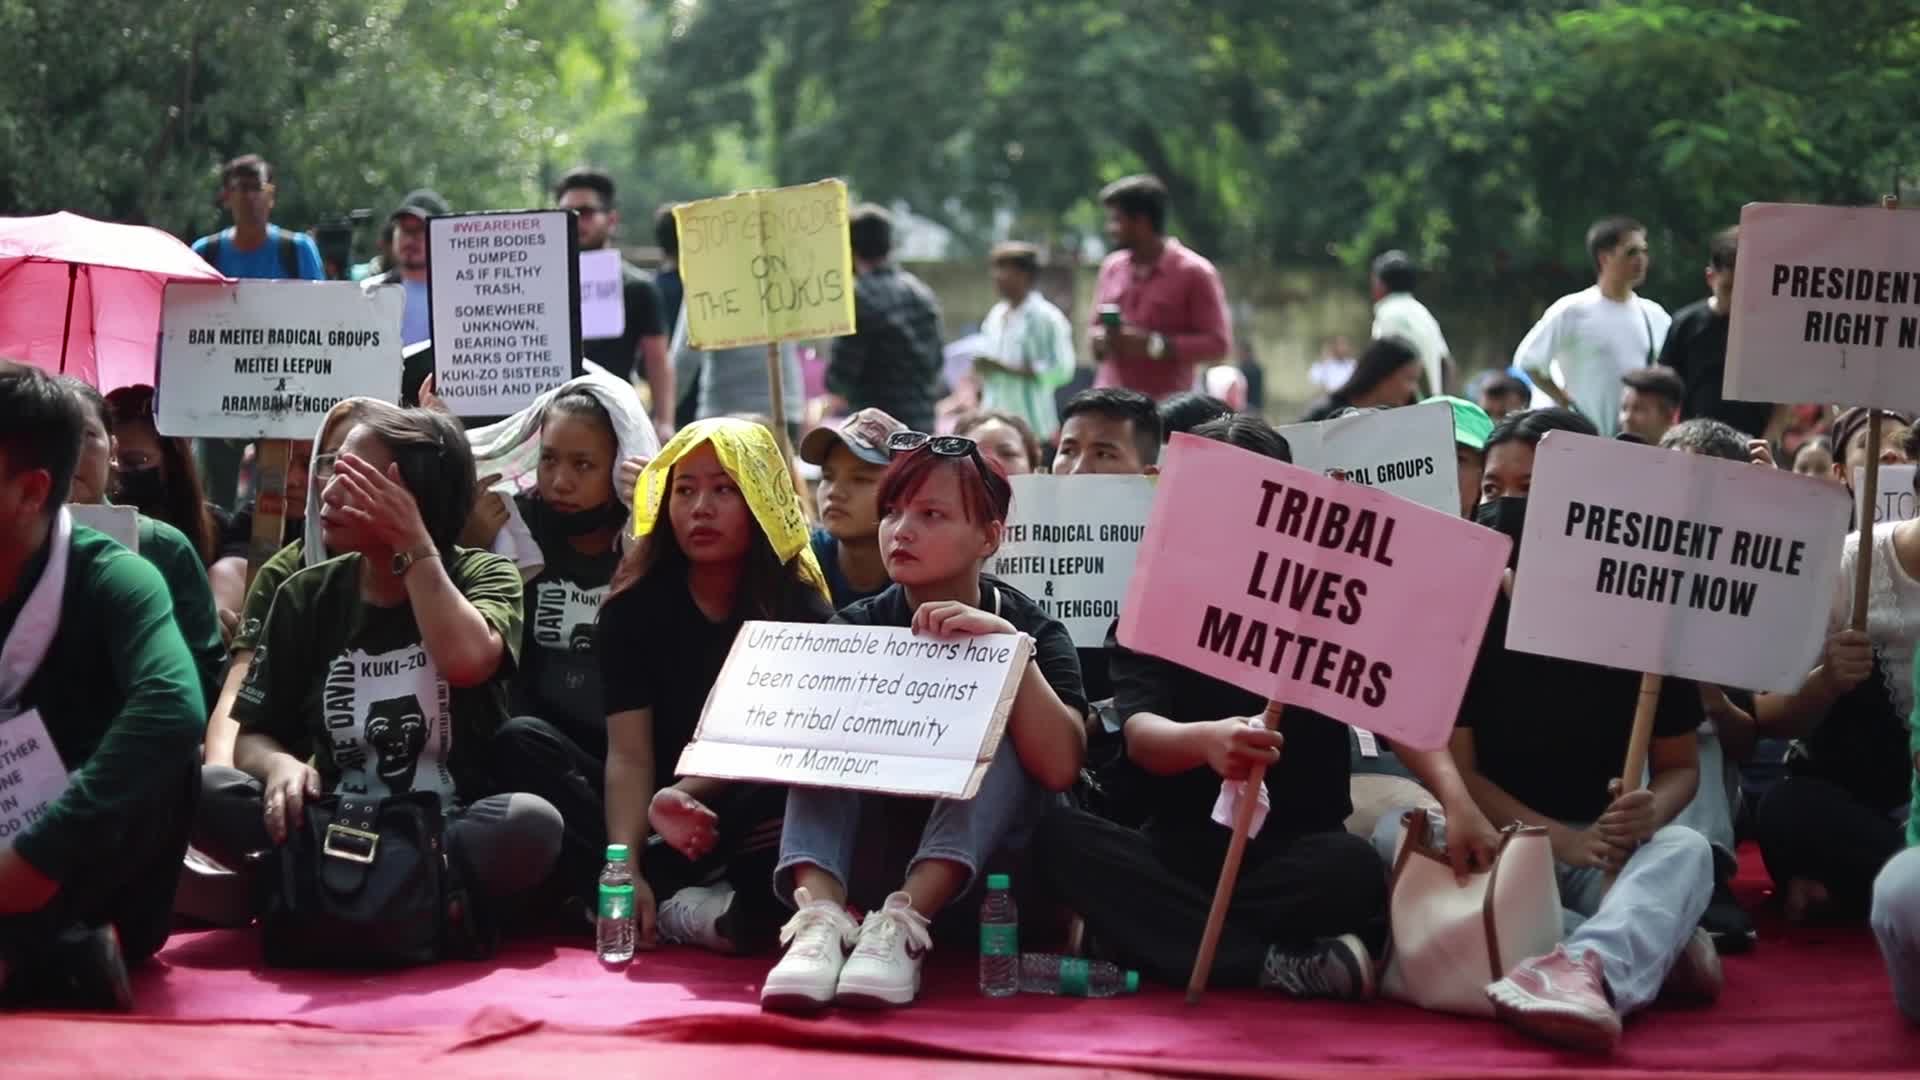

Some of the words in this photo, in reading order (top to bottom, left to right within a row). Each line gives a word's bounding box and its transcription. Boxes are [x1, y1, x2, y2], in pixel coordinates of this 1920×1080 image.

[453, 219, 541, 233] #WEAREHER
[685, 210, 738, 255] STOP
[449, 236, 490, 249] THEIR
[493, 233, 547, 248] BODIES
[468, 250, 528, 265] DUMPED
[751, 255, 788, 279] ON
[455, 269, 474, 281] AS
[478, 268, 490, 280] IF
[494, 265, 542, 279] FILTHY
[474, 284, 525, 296] TRASH,
[455, 302, 545, 318] SOMEWHERE
[692, 288, 741, 321] THE
[462, 319, 540, 333] UNKNOWN,
[1804, 311, 1889, 348] RIGHT
[1898, 317, 1920, 349] N
[189, 328, 215, 345] BAN
[220, 328, 264, 346] MEITEI
[268, 328, 323, 346] RADICAL
[328, 330, 380, 347] GROUPS
[454, 335, 518, 350] BEARING
[521, 334, 549, 347] THE
[234, 357, 279, 374] MEITEI
[283, 357, 332, 375] LEEPUN
[452, 352, 502, 365] MARKS
[441, 368, 498, 381] KUKI-ZO
[502, 365, 564, 379] SISTERS'
[436, 383, 497, 397] ANGUISH
[501, 382, 531, 395] AND
[289, 395, 343, 413] TENGGO
[1377, 456, 1434, 483] GROUPS
[1255, 479, 1396, 566] TRIBAL
[1032, 524, 1094, 543] RADICAL
[1564, 501, 1723, 561] PRESIDENT
[1731, 531, 1806, 576] RULE
[995, 556, 1045, 575] MEITEI
[1050, 556, 1104, 575] LEEPUN
[1045, 580, 1054, 596] &
[1247, 551, 1368, 625] LIVES
[1596, 557, 1685, 605] RIGHT
[1689, 573, 1759, 617] NOW
[537, 589, 566, 642] DAVID
[1056, 599, 1120, 618] TENGGOL
[748, 628, 879, 656] Unfathomable
[886, 638, 960, 662] horrors
[963, 639, 1010, 664] have
[1197, 605, 1393, 708] MATTERS
[361, 651, 427, 677] KUKI-ZO
[746, 664, 795, 689] been
[797, 671, 901, 696] committed
[905, 677, 978, 704] against
[326, 661, 355, 730] DAVID
[744, 703, 777, 728] the
[783, 706, 839, 731] tribal
[842, 712, 949, 746] community
[0, 738, 40, 768] THER
[776, 749, 793, 767] in
[796, 749, 880, 777] Manipur.
